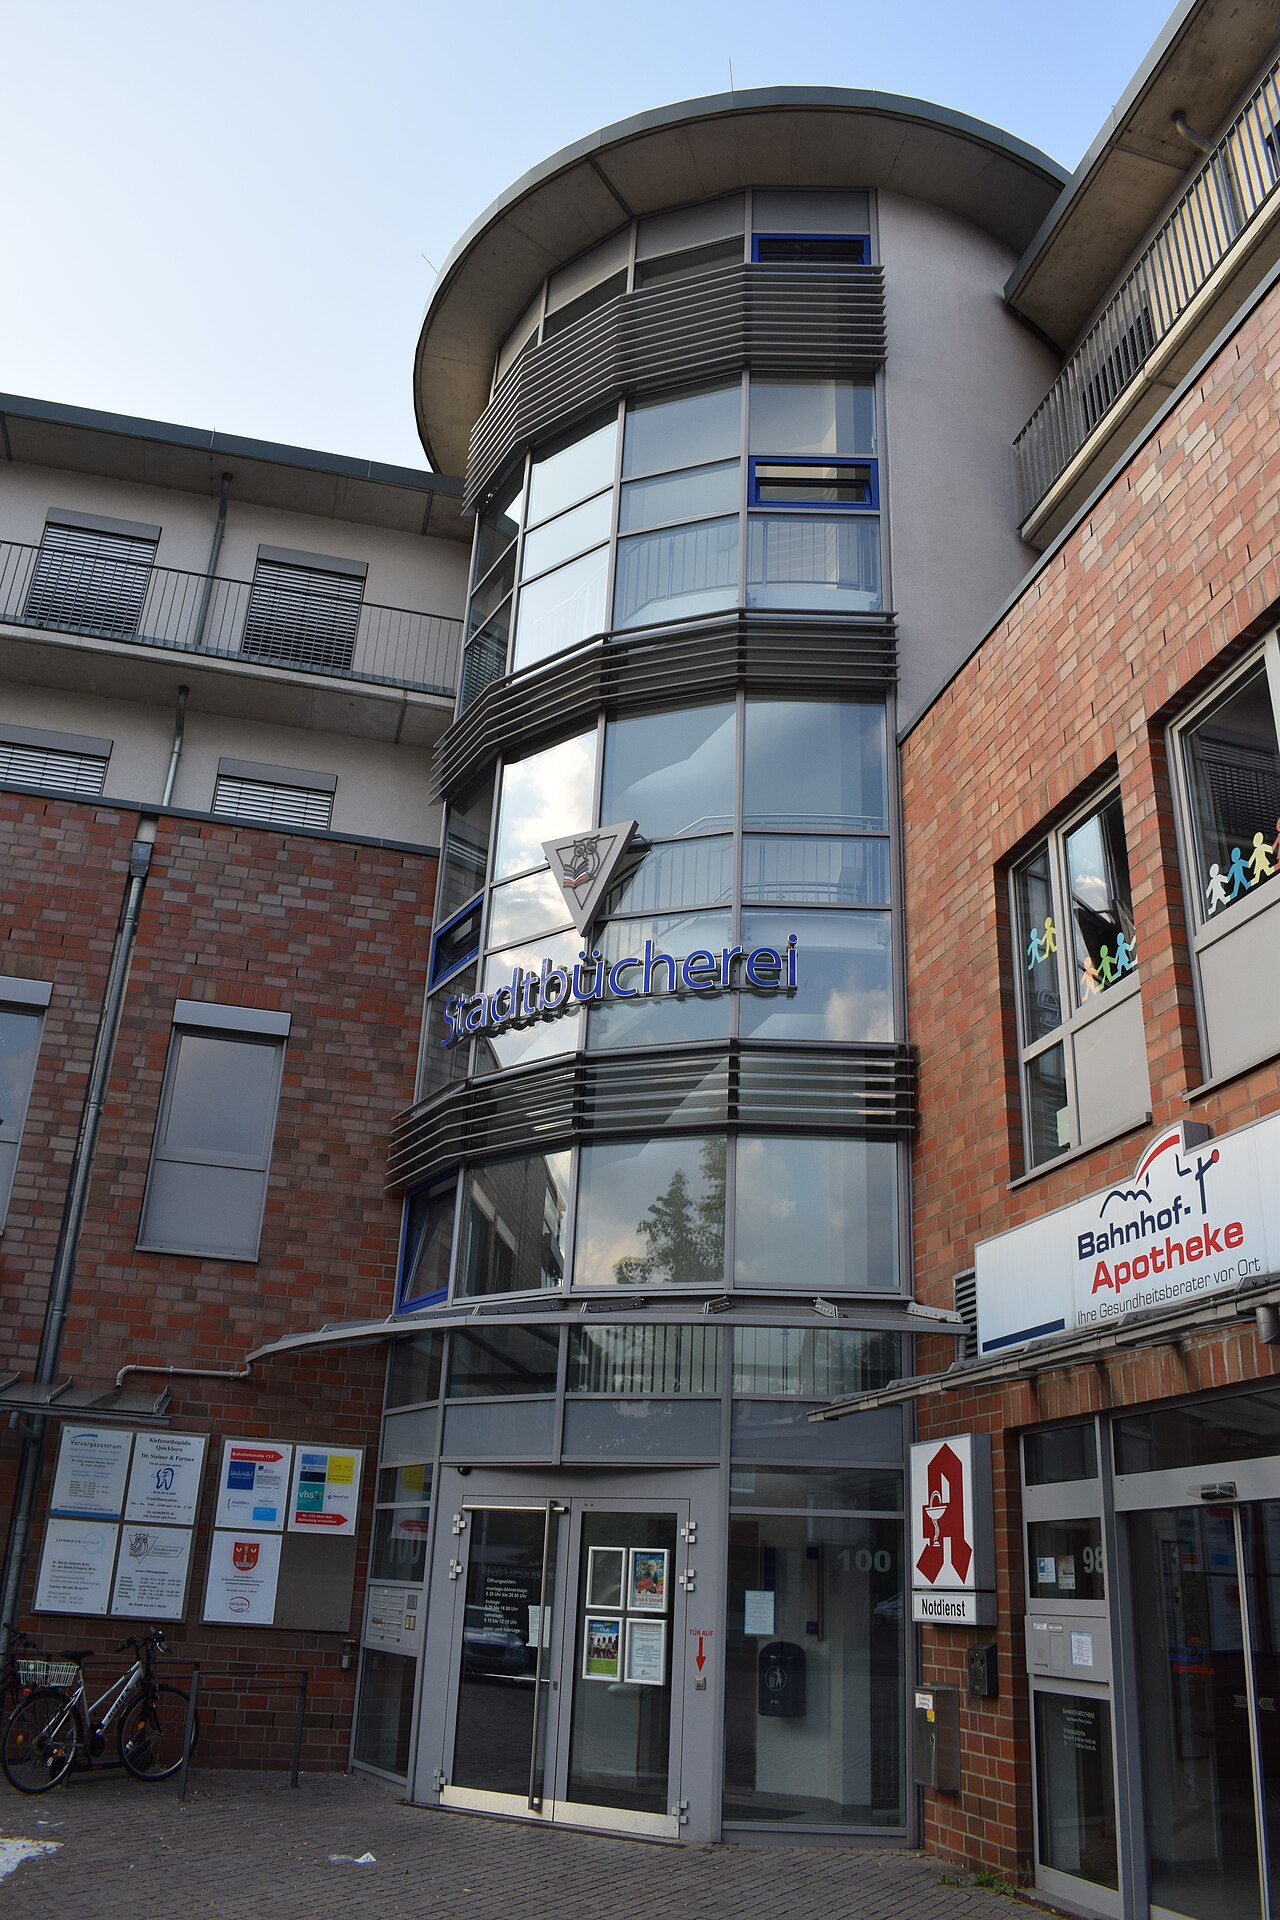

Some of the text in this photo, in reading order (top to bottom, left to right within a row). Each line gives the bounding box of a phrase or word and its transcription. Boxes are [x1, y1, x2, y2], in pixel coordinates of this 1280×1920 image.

[440, 933, 799, 1048] Stadtbücherei
[1078, 1195, 1191, 1260] Bahnhof-
[1091, 1221, 1244, 1294] Apotheke
[1077, 1257, 1261, 1325] Ihre Gesundheitsberater vor Ort
[70, 1439, 122, 1449] Vorsorgezentrum
[149, 1438, 192, 1446] Kieferorthopädie
[299, 1490, 314, 1499] vhs
[837, 1549, 892, 1573] 100
[1082, 1546, 1104, 1574] 98
[922, 1598, 966, 1617] Notdienst
